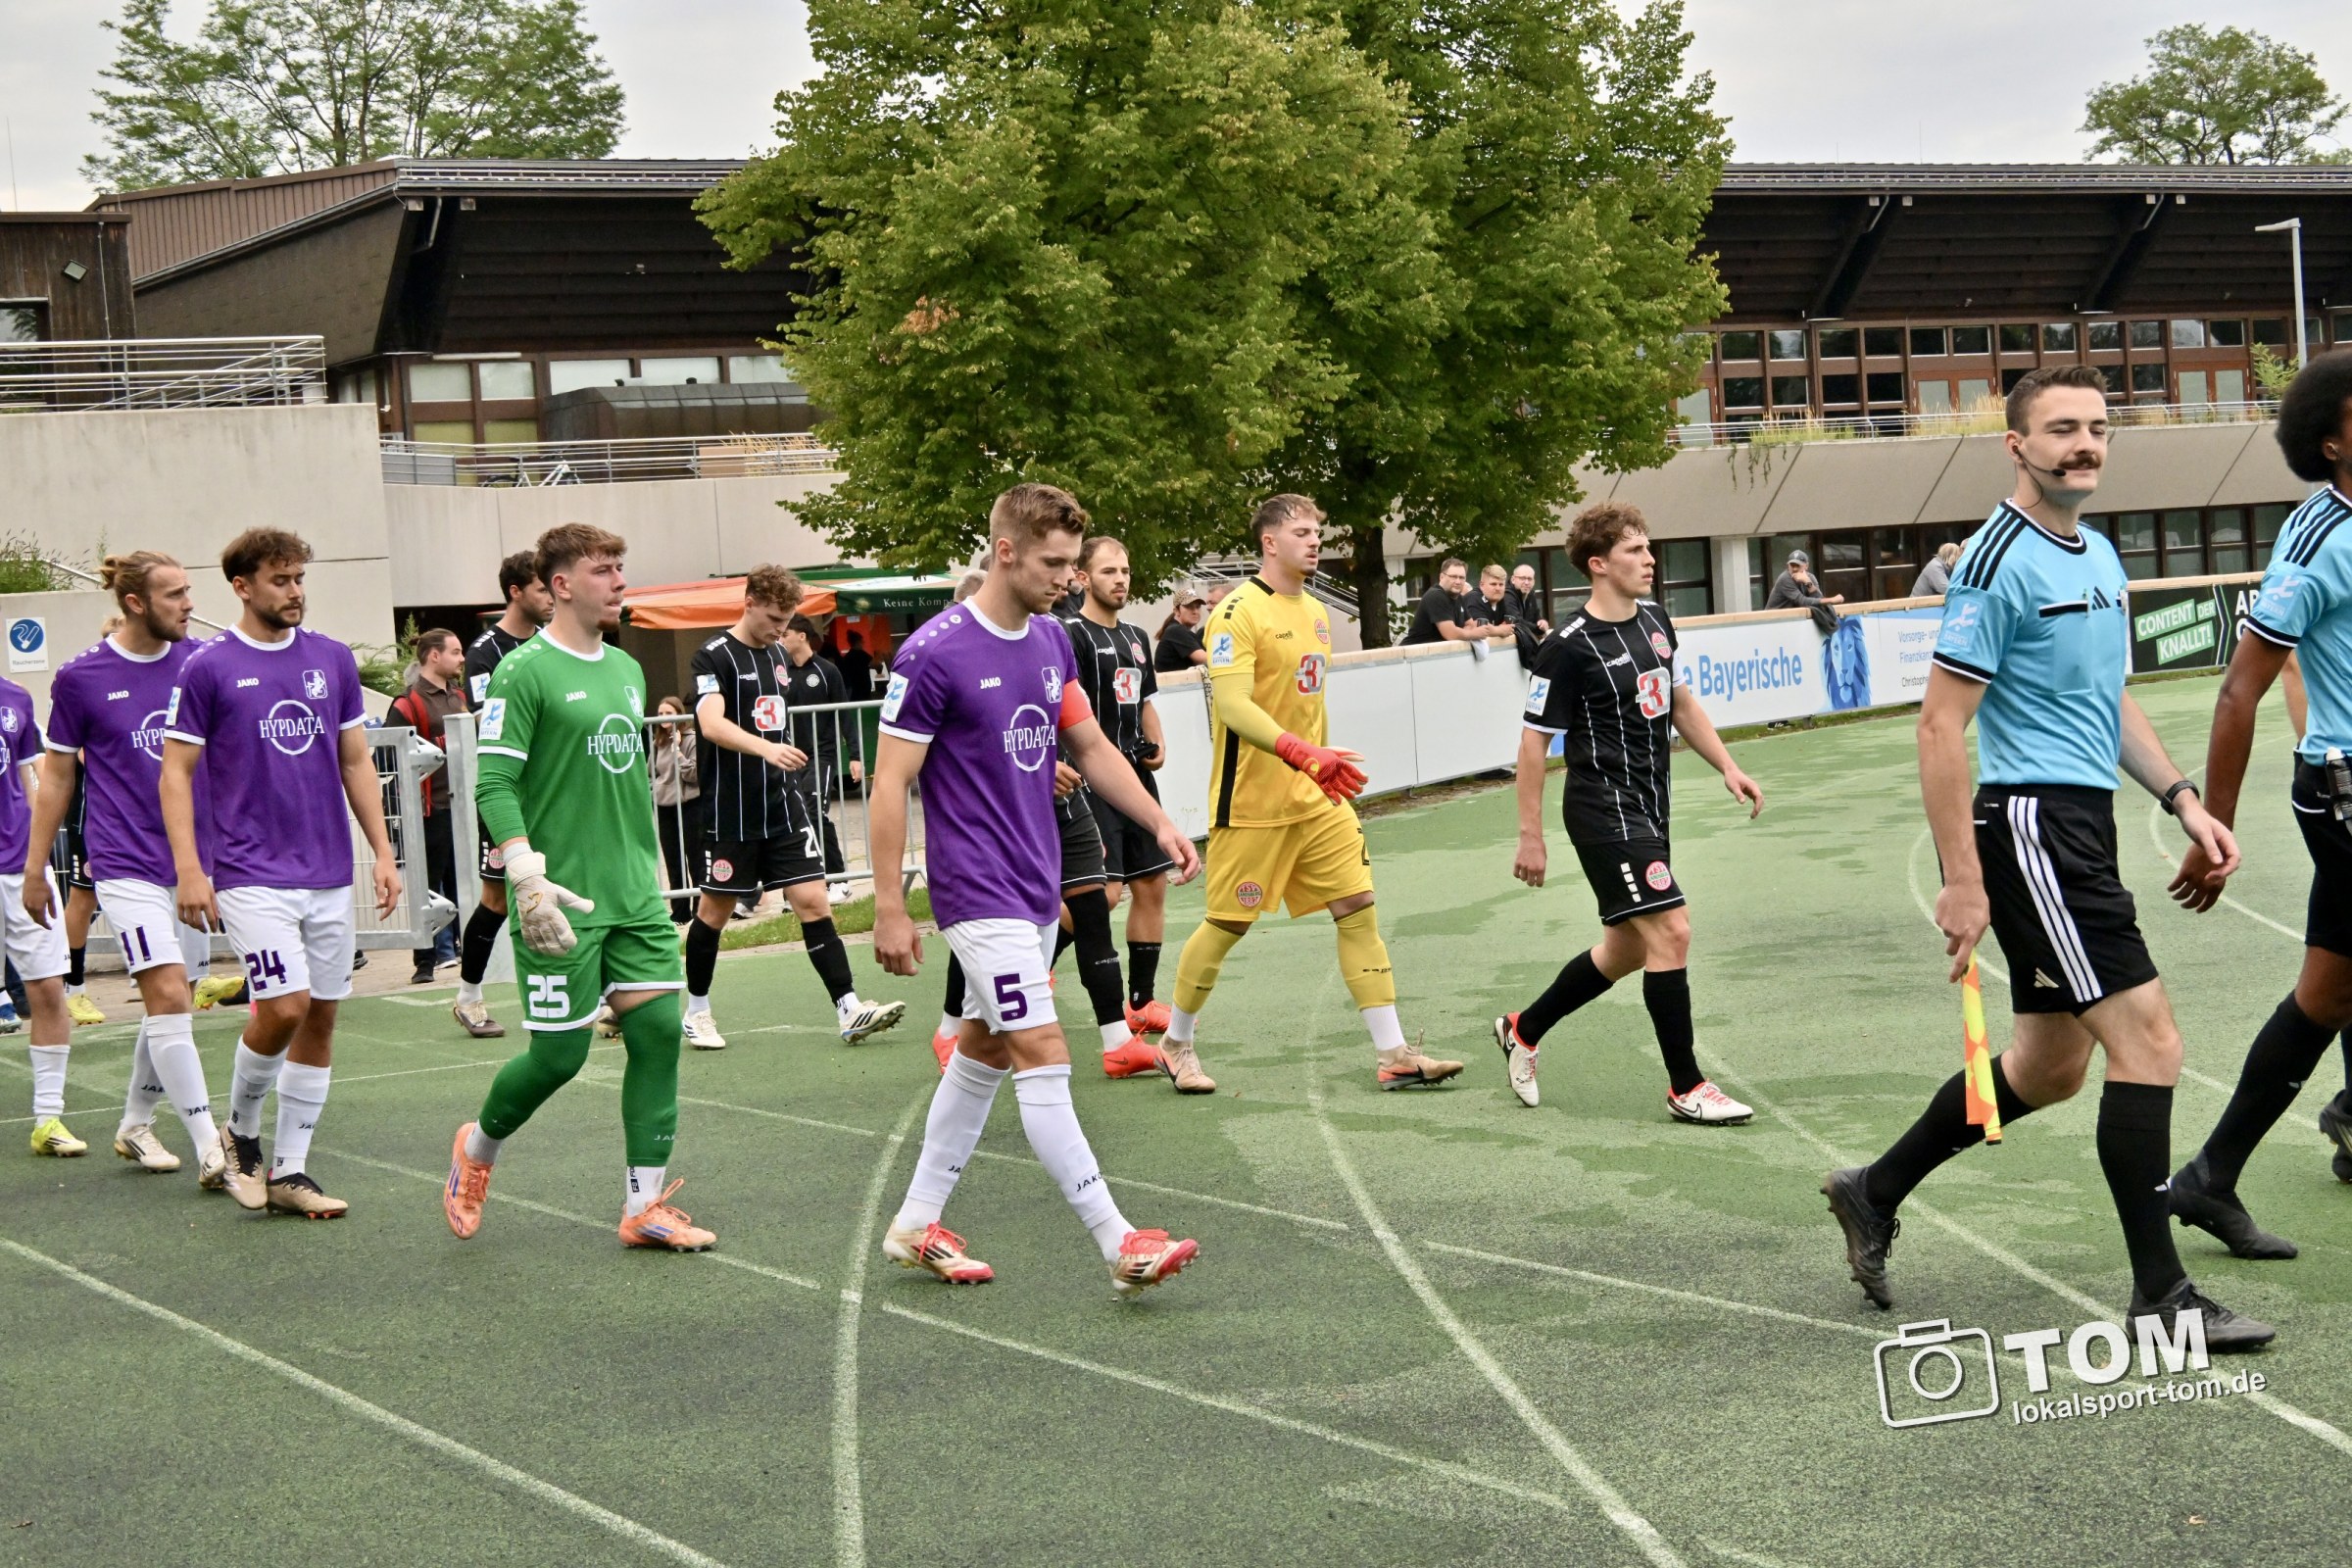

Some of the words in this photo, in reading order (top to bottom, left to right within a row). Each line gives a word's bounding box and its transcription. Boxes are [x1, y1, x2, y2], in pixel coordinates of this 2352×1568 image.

[883, 598, 914, 608] Keine
[2137, 603, 2194, 637] CONTENT
[2198, 603, 2216, 619] DER
[1898, 629, 1928, 643] Vorsorge-
[2158, 624, 2213, 662] KNALLT!
[237, 677, 260, 688] JAKO
[980, 676, 1002, 690] JAKO
[1698, 646, 1803, 703] Bayerische
[107, 690, 129, 701] JAKO
[564, 690, 587, 703] JAKO
[259, 715, 325, 739] HYPDATA
[1003, 724, 1057, 754] HYPDATA
[587, 732, 645, 756] HYPDATA
[121, 925, 152, 966] 11
[245, 949, 287, 992] 24
[527, 974, 570, 1019] 25
[994, 973, 1028, 1022] 5
[141, 1084, 166, 1093] JAK
[948, 1164, 961, 1173] JA
